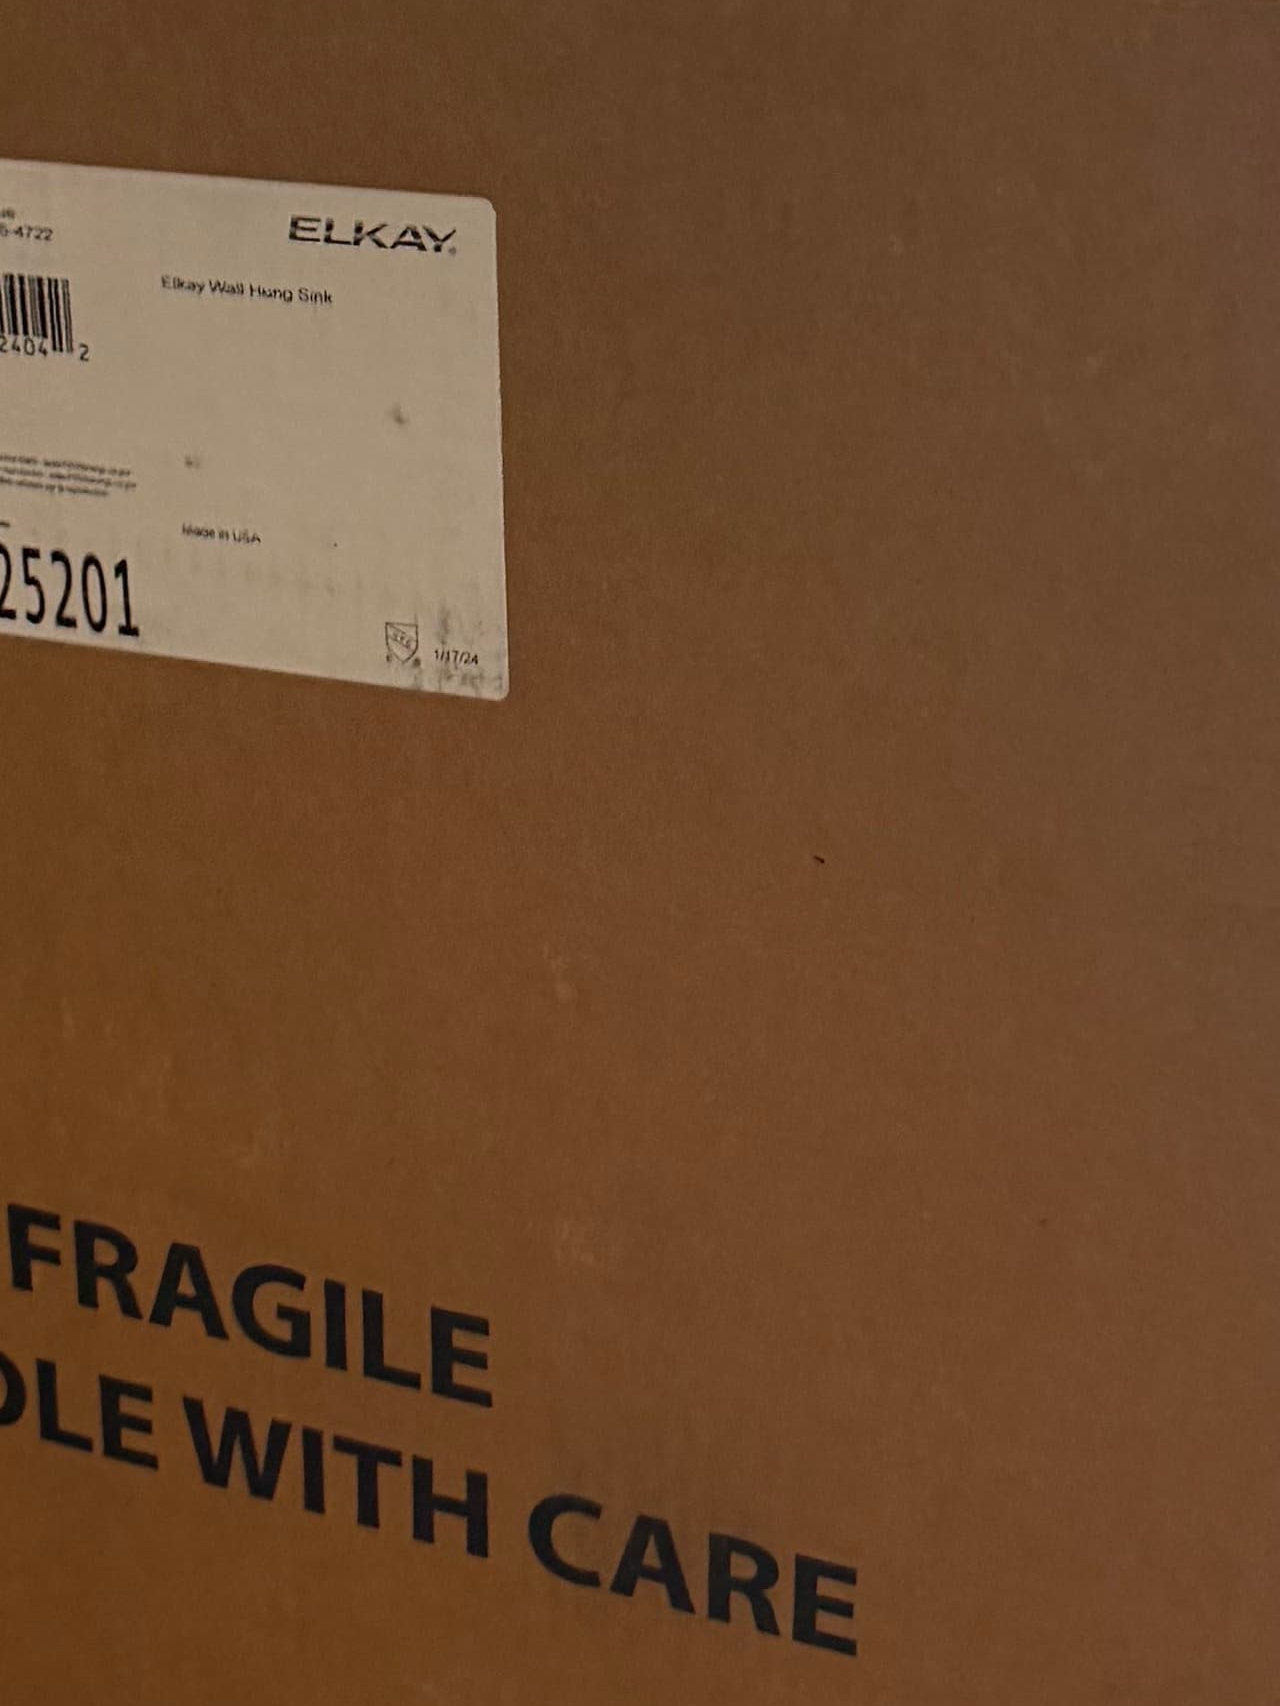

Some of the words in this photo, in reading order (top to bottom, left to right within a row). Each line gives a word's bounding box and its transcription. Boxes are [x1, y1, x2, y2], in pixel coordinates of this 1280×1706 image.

[161, 275, 205, 293] Elkay
[209, 279, 244, 296] Wall
[249, 283, 293, 303] Hung
[298, 287, 333, 305] Sink
[79, 343, 90, 362] 2
[6, 1203, 493, 1408] FRAGILE
[183, 1395, 488, 1558] WITH
[527, 1494, 859, 1658] CARE
